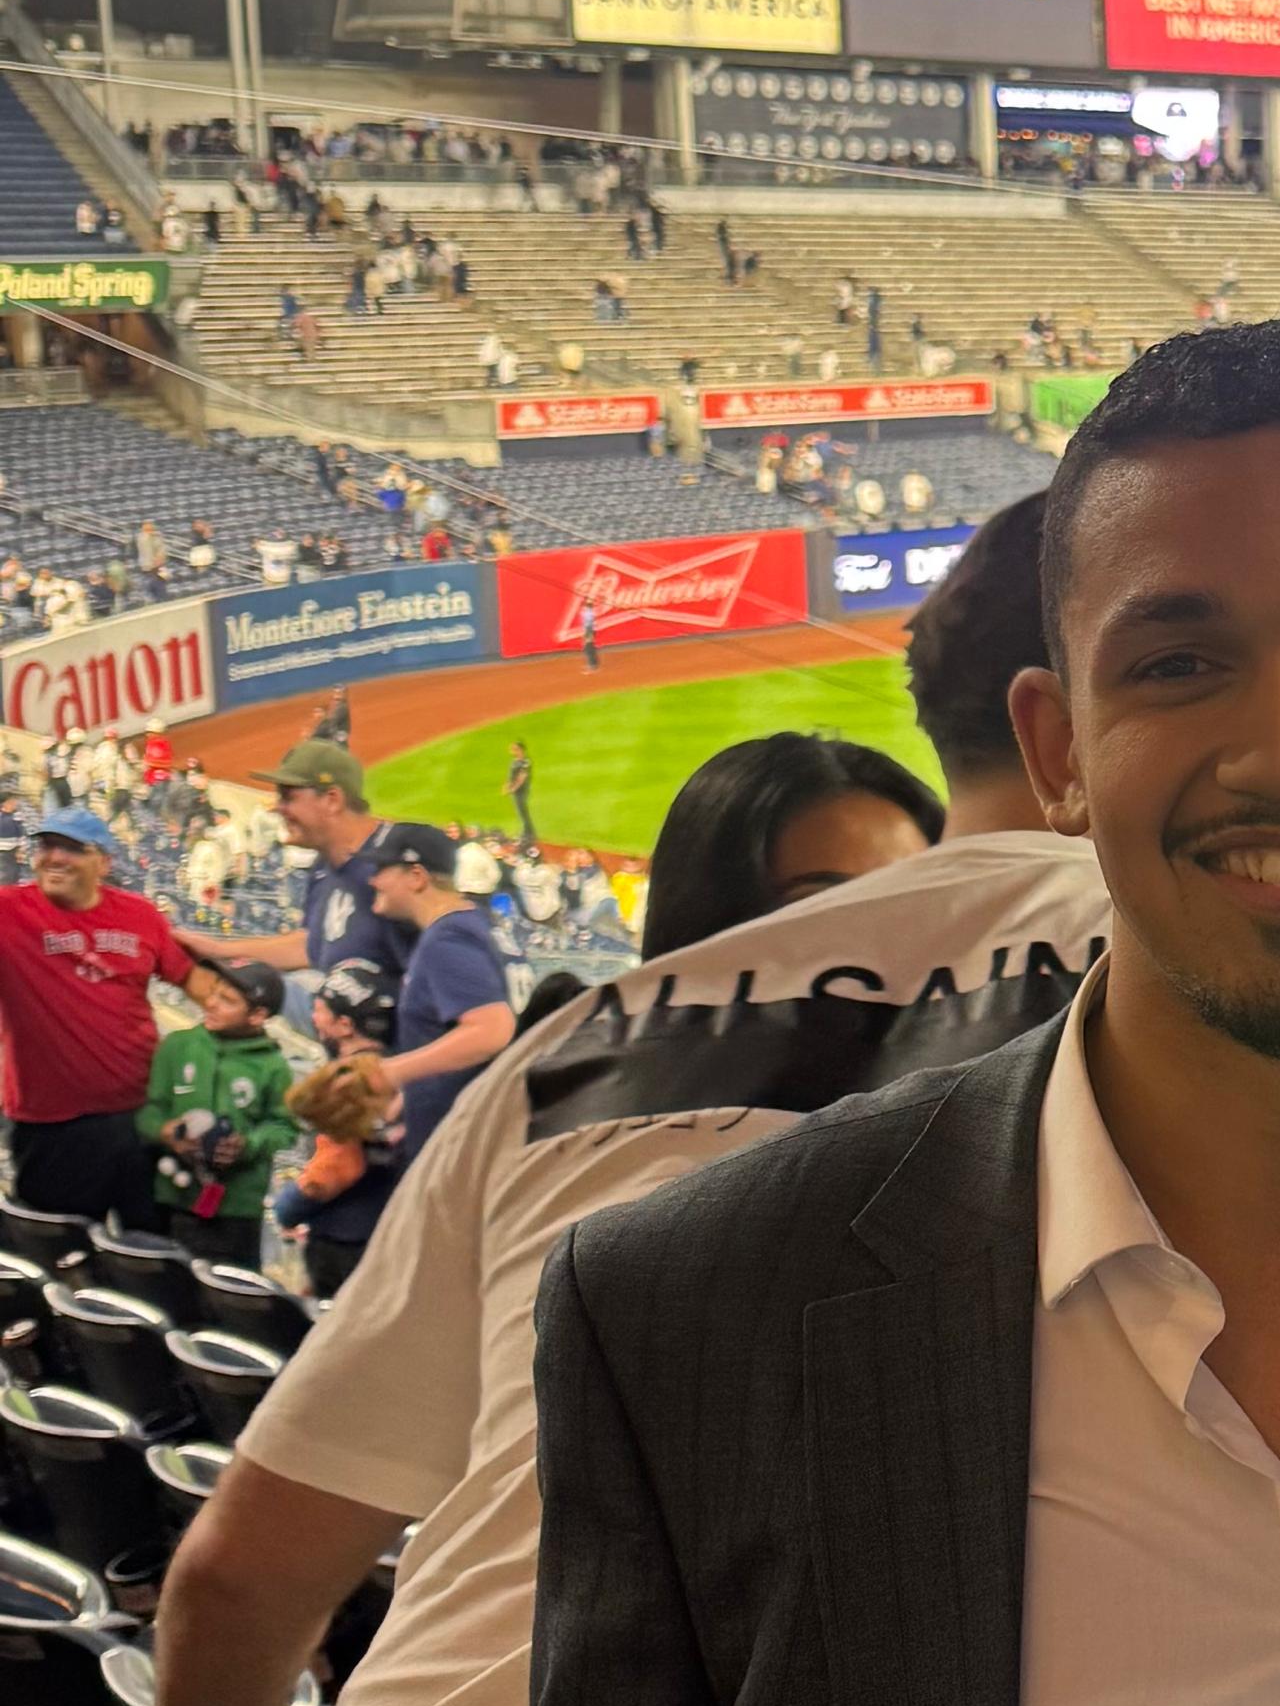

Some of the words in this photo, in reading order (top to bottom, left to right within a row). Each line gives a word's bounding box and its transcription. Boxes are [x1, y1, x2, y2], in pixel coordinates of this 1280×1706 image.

[1166, 13, 1194, 40] IN
[73, 263, 154, 306] Spring
[575, 572, 741, 615] Budweiser
[225, 599, 358, 655] Montefiore
[357, 580, 473, 631] Einstein
[7, 629, 204, 742] Canon
